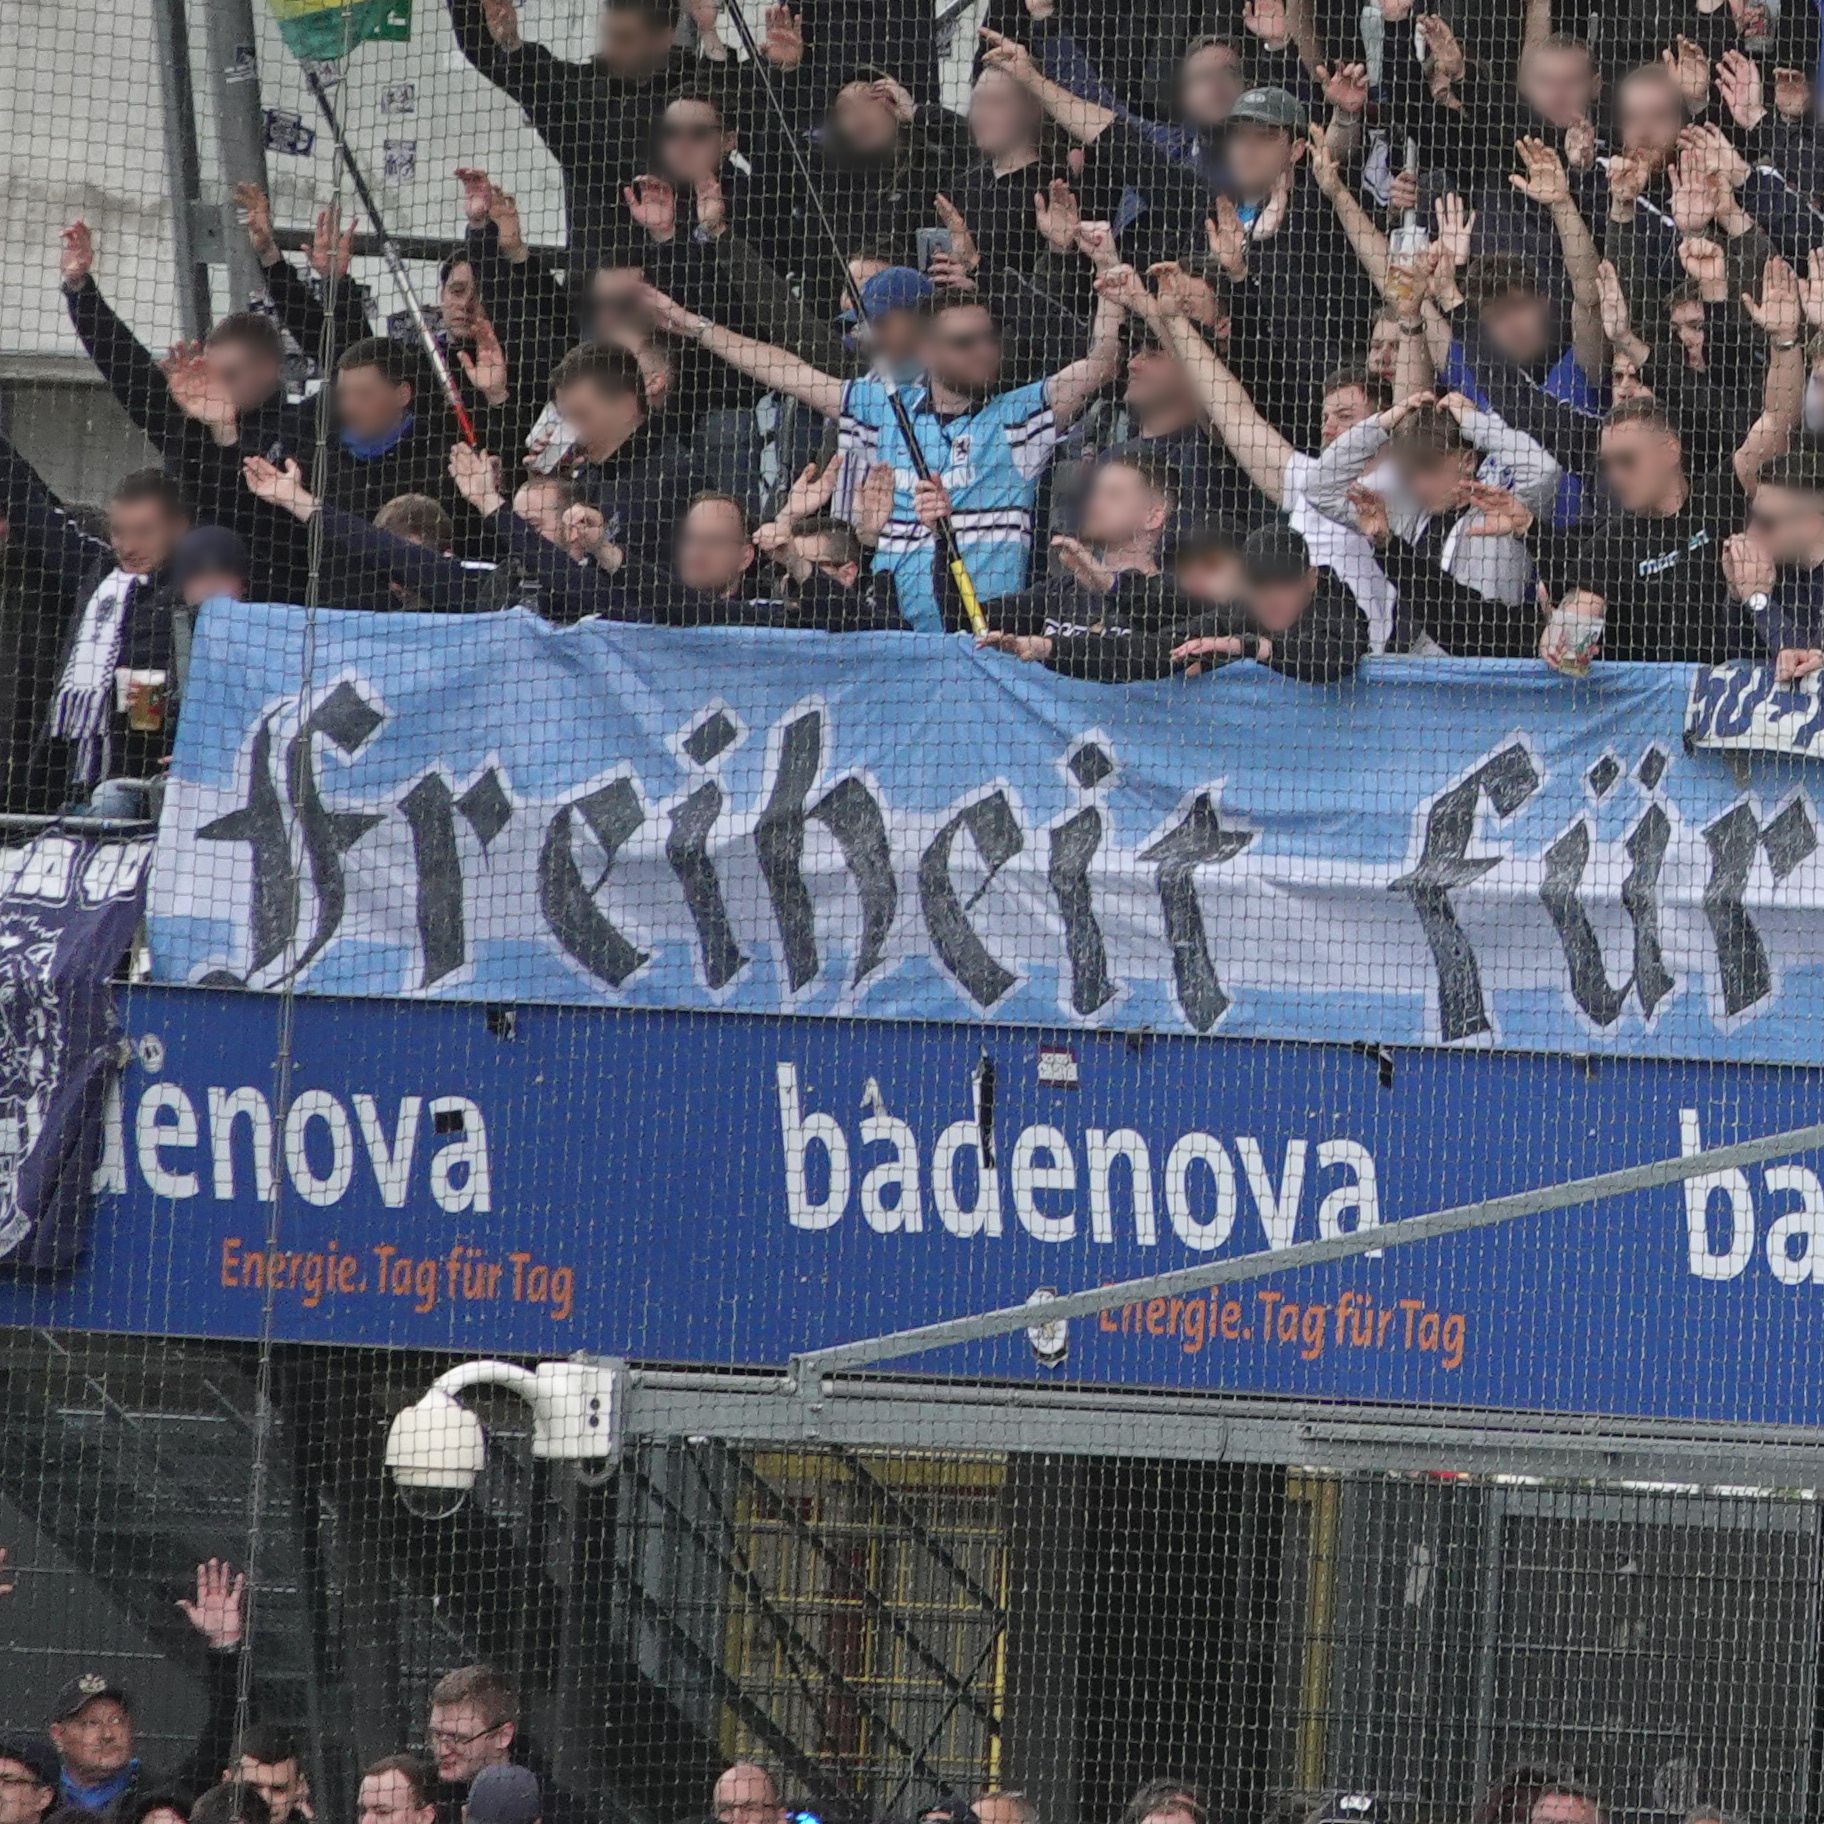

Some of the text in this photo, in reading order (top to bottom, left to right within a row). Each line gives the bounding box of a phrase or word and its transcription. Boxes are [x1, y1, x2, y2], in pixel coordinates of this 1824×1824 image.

[1387, 739, 1819, 1044] für
[775, 1061, 1384, 1259] badenova
[374, 1243, 438, 1314] Tag
[448, 1246, 501, 1301] für
[509, 1251, 575, 1321] Tag
[1258, 1290, 1325, 1361] Tag
[1336, 1292, 1395, 1350] für
[1401, 1299, 1467, 1370] Tag
